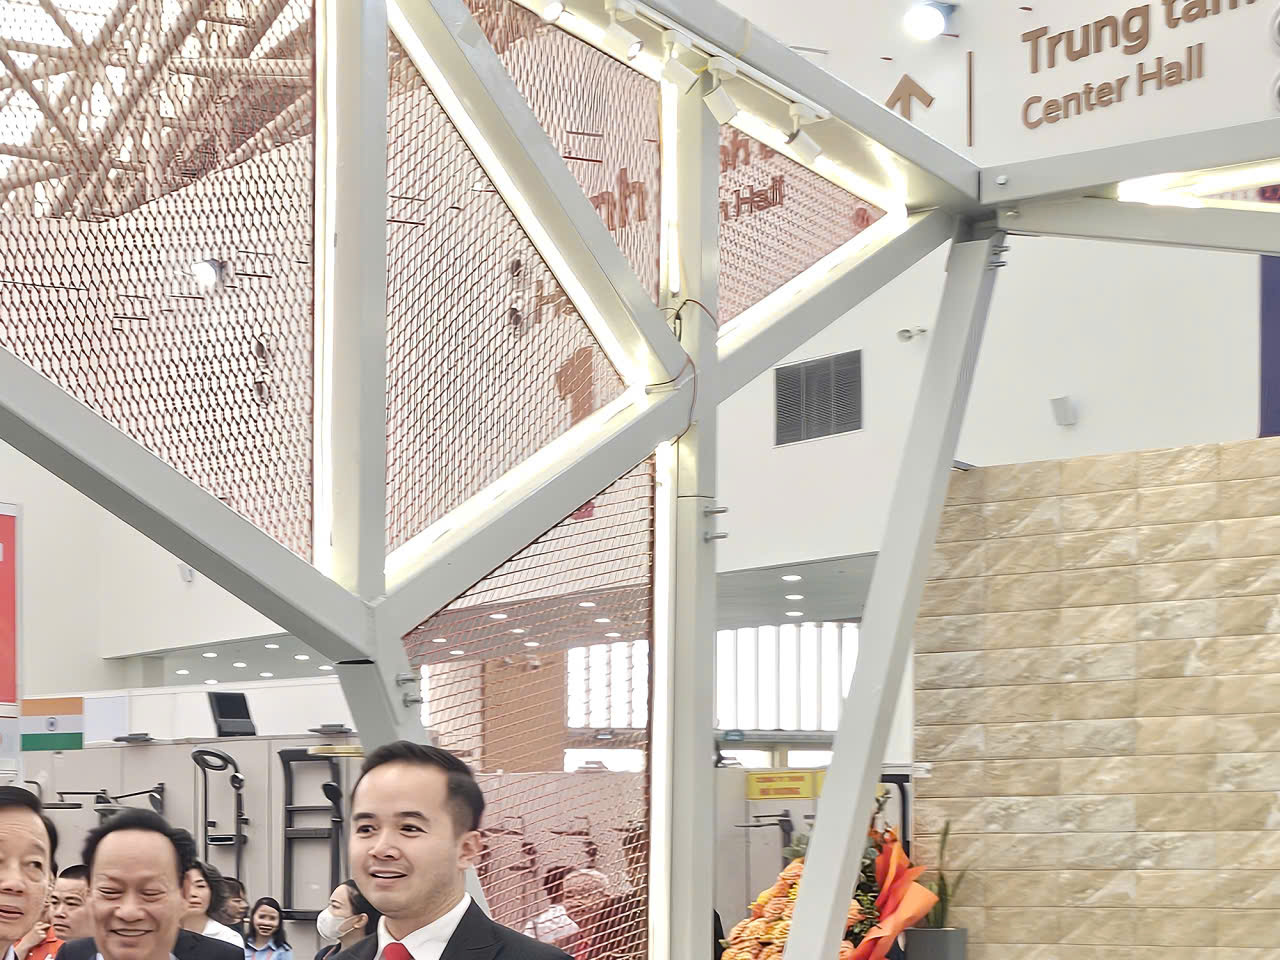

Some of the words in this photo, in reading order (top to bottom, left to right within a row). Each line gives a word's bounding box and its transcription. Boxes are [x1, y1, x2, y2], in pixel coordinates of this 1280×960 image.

[1021, 4, 1151, 73] Trung
[1022, 75, 1130, 129] Center
[1136, 42, 1206, 96] Hall
